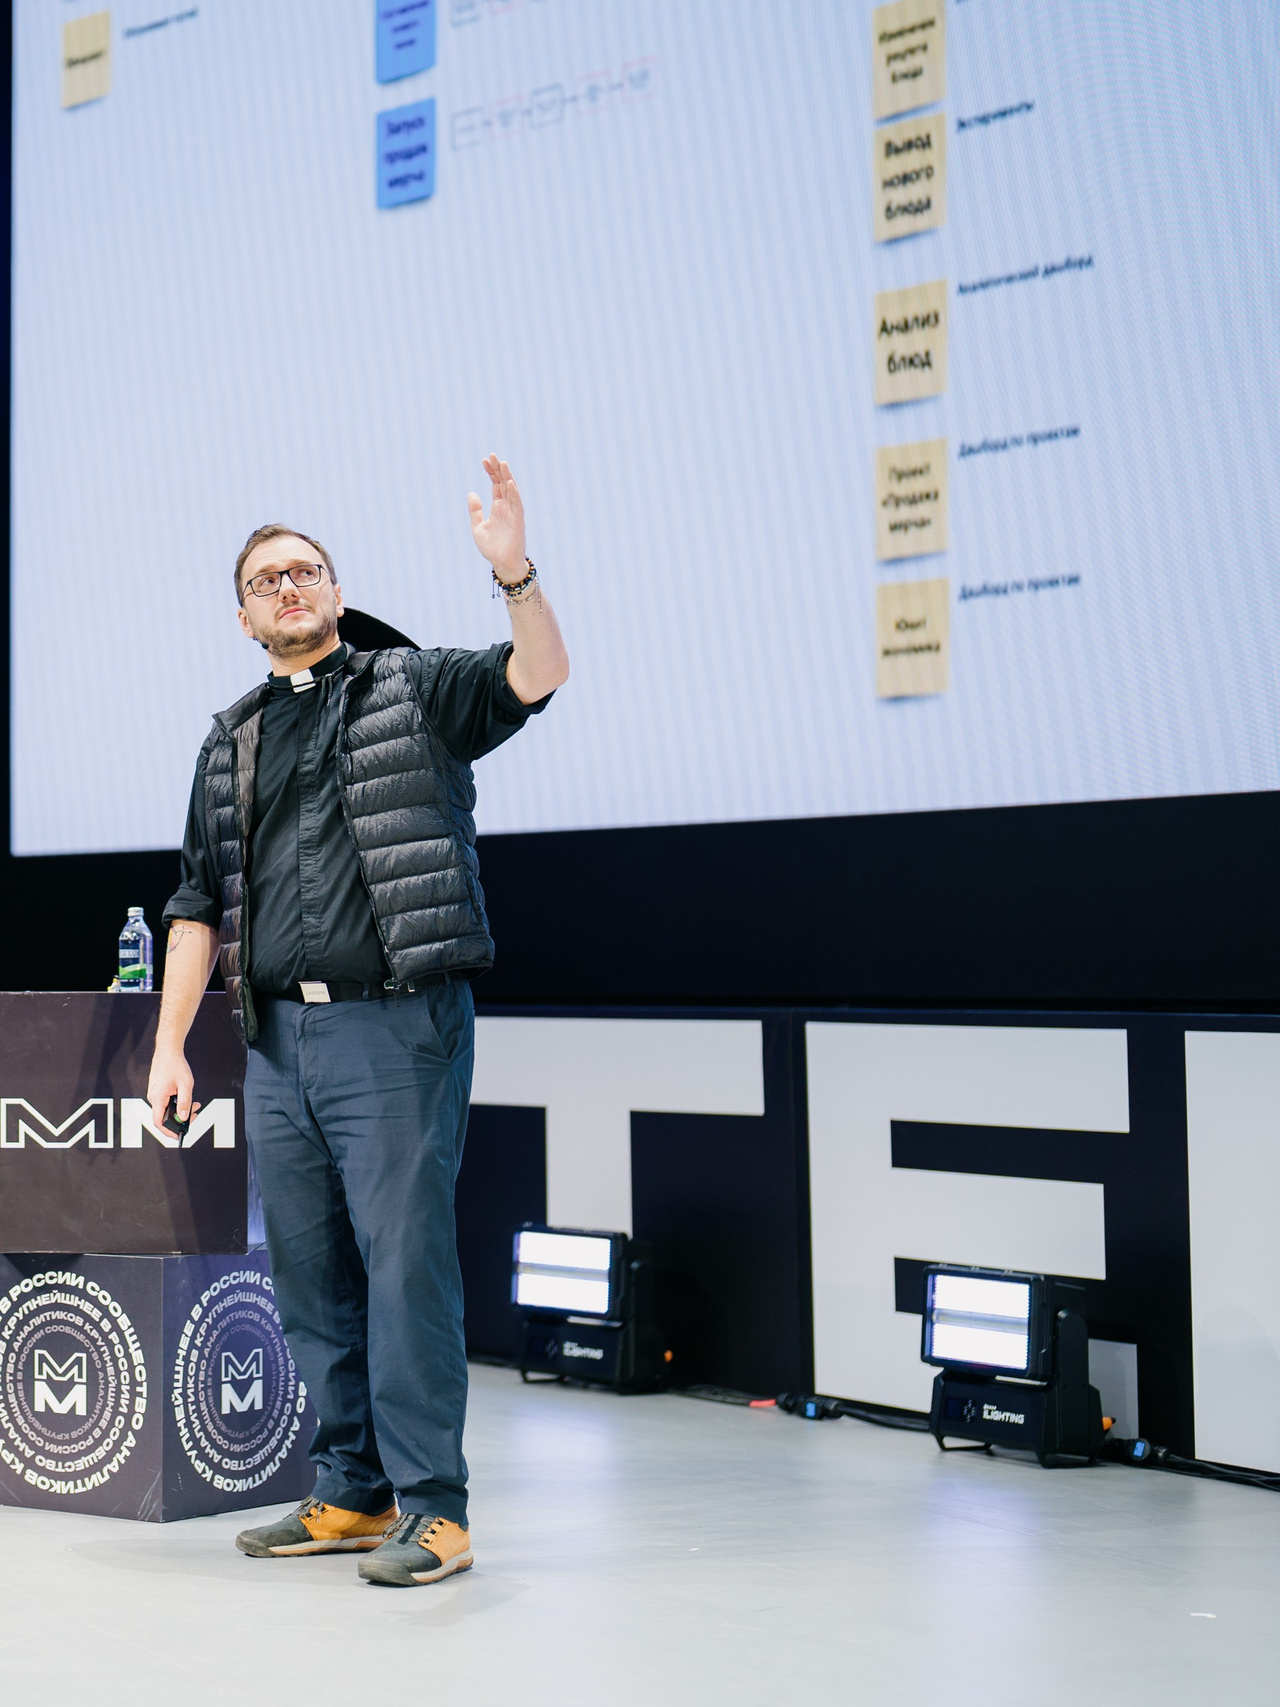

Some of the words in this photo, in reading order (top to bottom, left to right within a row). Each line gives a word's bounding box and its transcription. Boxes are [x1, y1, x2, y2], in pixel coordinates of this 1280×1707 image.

[884, 131, 933, 159] Вывод
[882, 163, 935, 191] нового
[884, 195, 933, 221] блюда
[878, 308, 940, 339] Анализ
[886, 348, 933, 375] блюд
[888, 463, 931, 483] Проект
[8, 1270, 85, 1302] РОССИИ
[200, 1270, 261, 1307] РОССИИ
[12, 1310, 84, 1352] АНАЛИТИКОВ
[99, 1317, 113, 1333] В
[190, 1303, 203, 1322] В
[17, 1329, 45, 1370] РОССИИ
[44, 1324, 102, 1369] СООБЩЕСТВО
[203, 1309, 261, 1358] АНАЛИТИКОВ
[85, 1281, 148, 1430] СООБЩЕСТВО
[107, 1331, 131, 1414] РОССИИ
[5, 1352, 45, 1447] СООБЩЕСТВО
[70, 1371, 105, 1439] АНАЛИТИКОВ
[186, 1349, 222, 1464] АНАЛИТИКОВ
[198, 1359, 230, 1449] СООБЩЕСТВО
[34, 1415, 126, 1473] СООБЩЕСТВО
[44, 1435, 94, 1455] РОССИИ
[212, 1415, 301, 1492] АНАЛИТИКОВ
[221, 1402, 292, 1471] СООБЩЕСТВО
[229, 1428, 269, 1453] РОССИИ
[24, 1430, 137, 1494] АНАЛИТИКОВ
